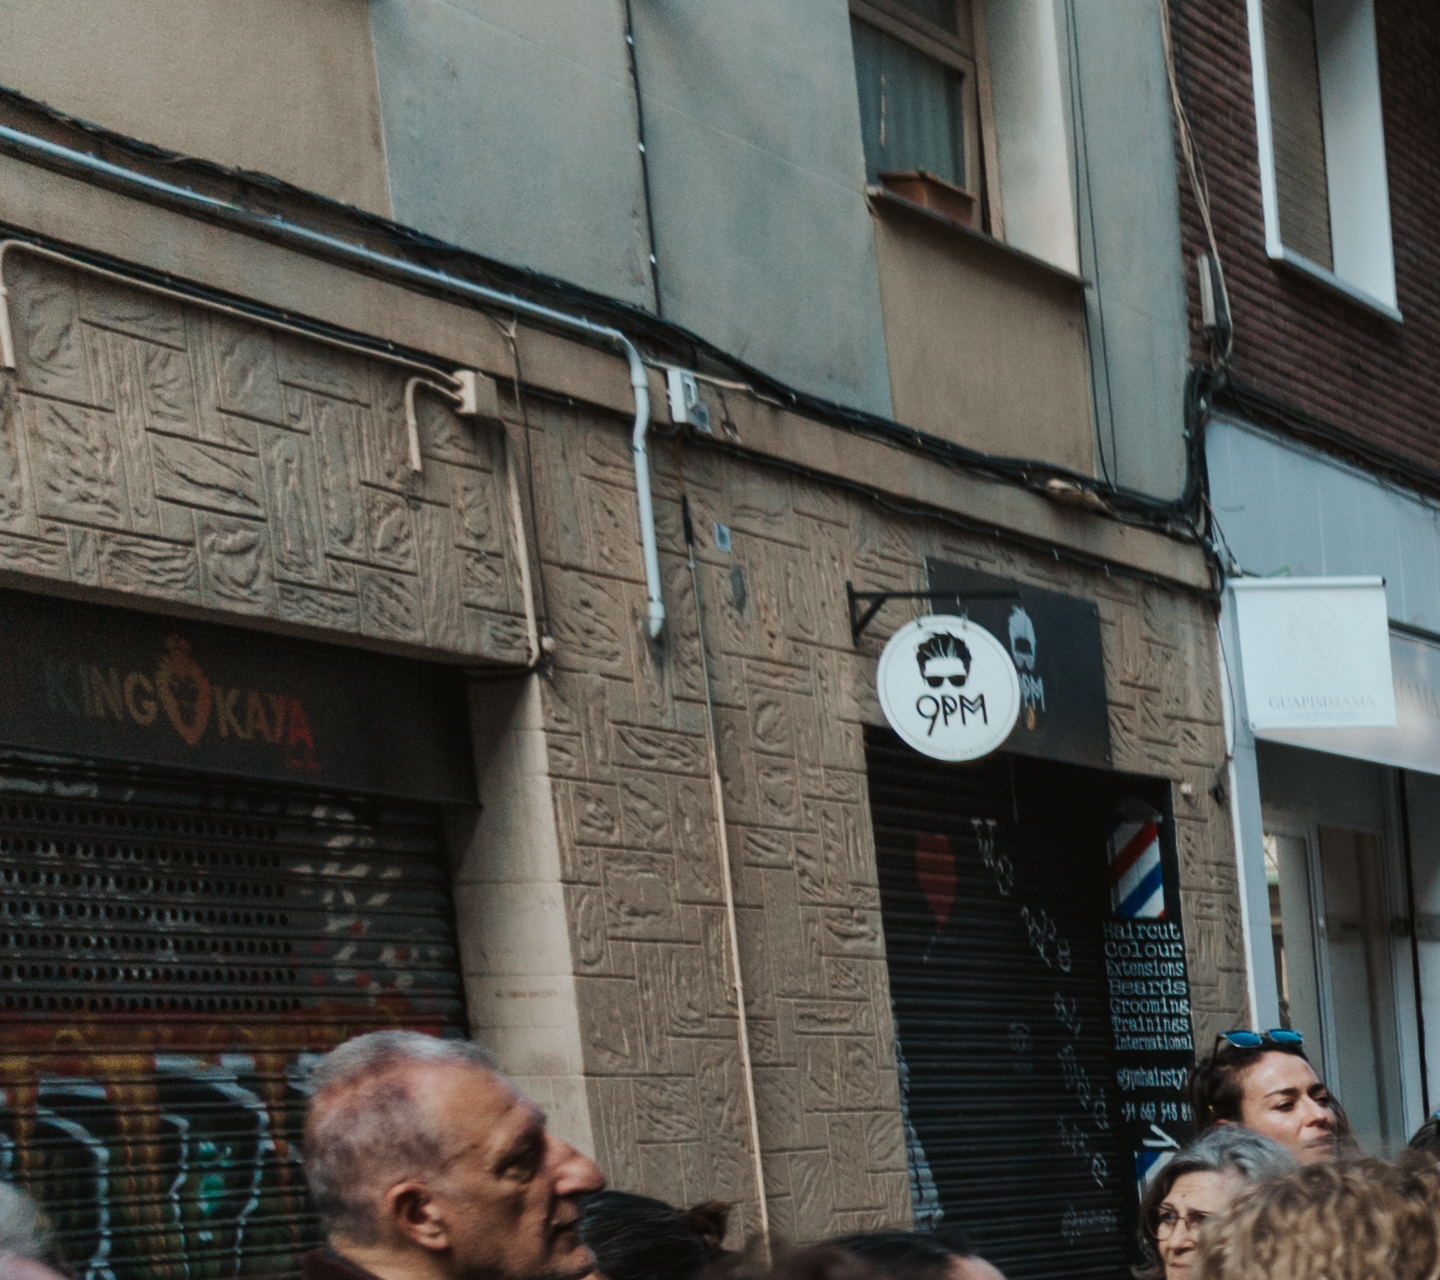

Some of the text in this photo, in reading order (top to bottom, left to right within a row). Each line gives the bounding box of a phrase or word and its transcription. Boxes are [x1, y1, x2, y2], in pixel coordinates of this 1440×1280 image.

[916, 694, 988, 736] 9PM
[1103, 921, 1181, 940] Haircut
[1104, 941, 1183, 958] Colour
[1106, 960, 1184, 977] Extensions
[1108, 978, 1187, 995] Beards
[1110, 997, 1191, 1015] Grooming
[1111, 1015, 1189, 1033] Trainings
[1115, 1034, 1193, 1050] International
